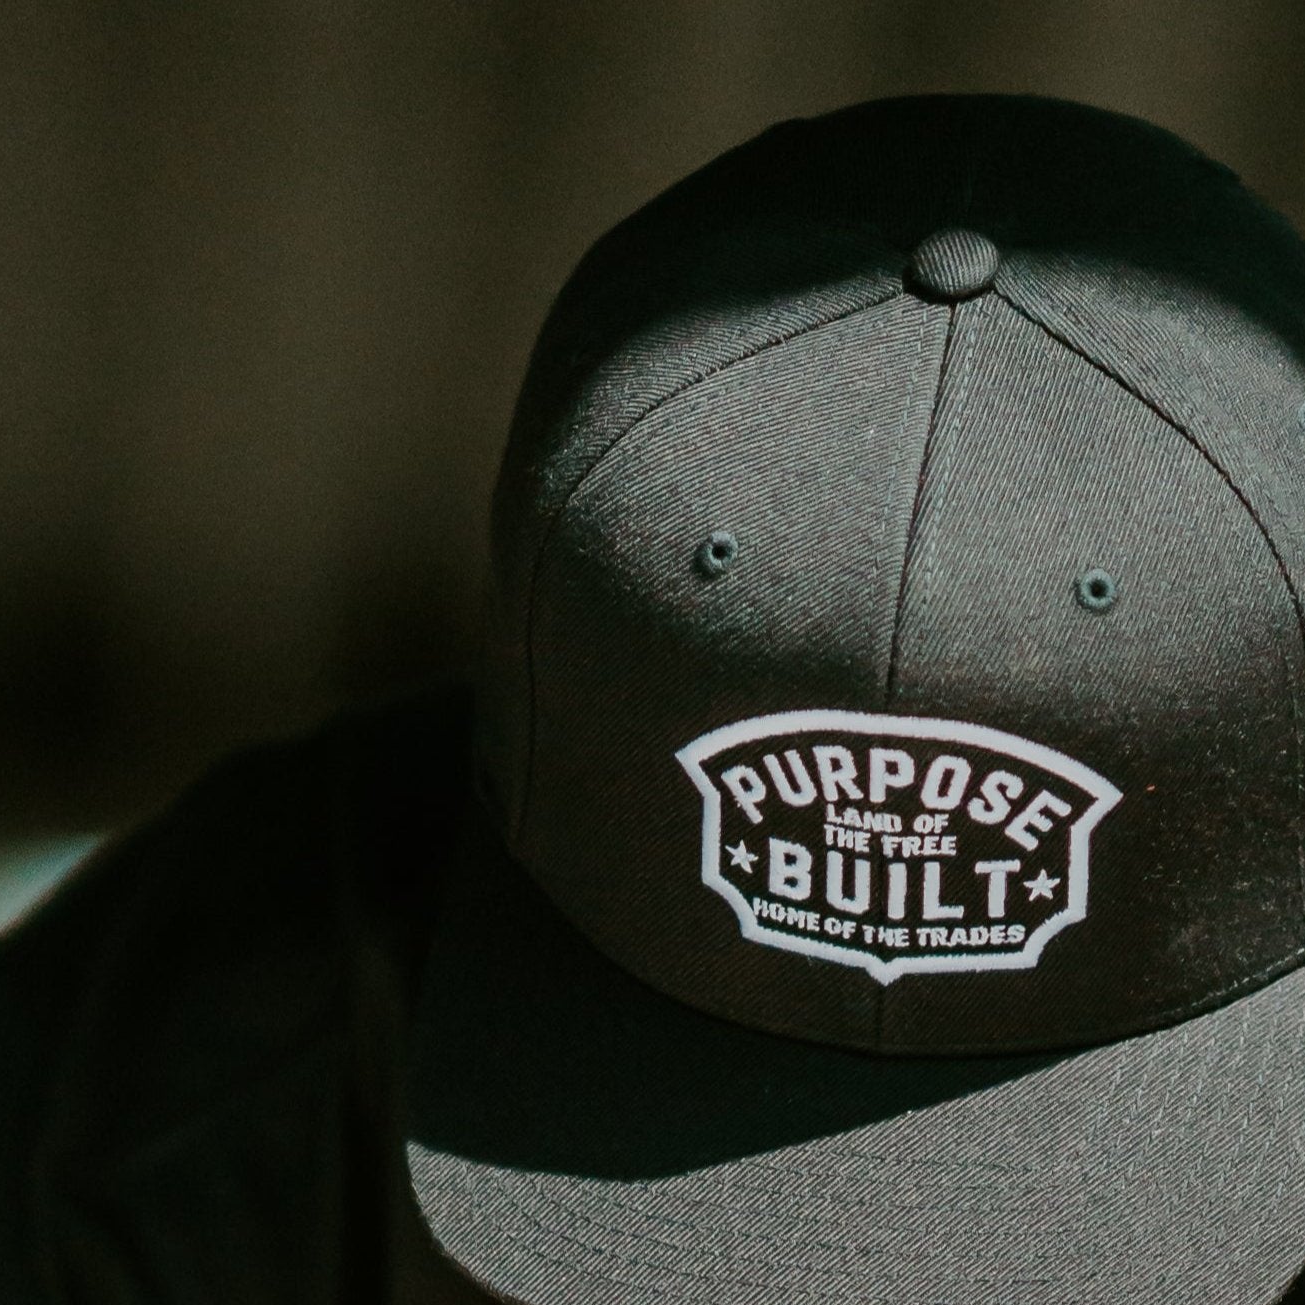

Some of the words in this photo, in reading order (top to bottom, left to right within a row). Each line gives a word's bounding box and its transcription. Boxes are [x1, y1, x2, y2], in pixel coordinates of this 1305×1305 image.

[721, 745, 1072, 851] PURPOSE
[825, 803, 902, 832] LAND
[913, 813, 950, 833] OF
[823, 824, 870, 852] THE
[882, 834, 957, 858] FREE
[769, 837, 1021, 920] BUILT
[753, 897, 820, 929] HOME
[824, 916, 856, 939] OF
[863, 924, 910, 947] THE
[917, 924, 1026, 947] TRADES
